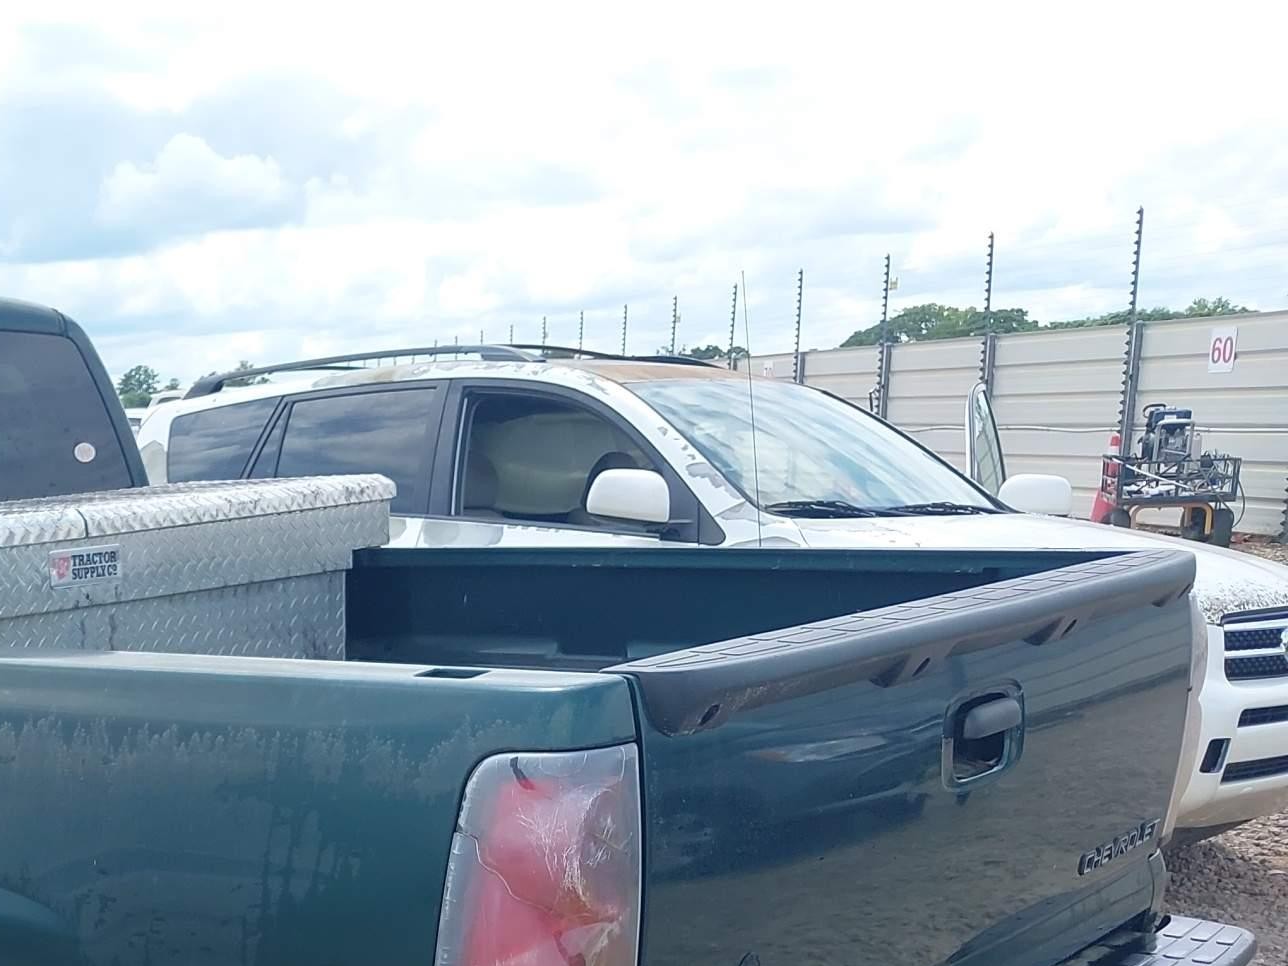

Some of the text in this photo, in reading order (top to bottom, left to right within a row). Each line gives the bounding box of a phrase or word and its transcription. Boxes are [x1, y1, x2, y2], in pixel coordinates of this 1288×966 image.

[1211, 336, 1234, 364] 60
[71, 551, 117, 567] TRACTOR
[1078, 818, 1161, 875] CHEVROLET
